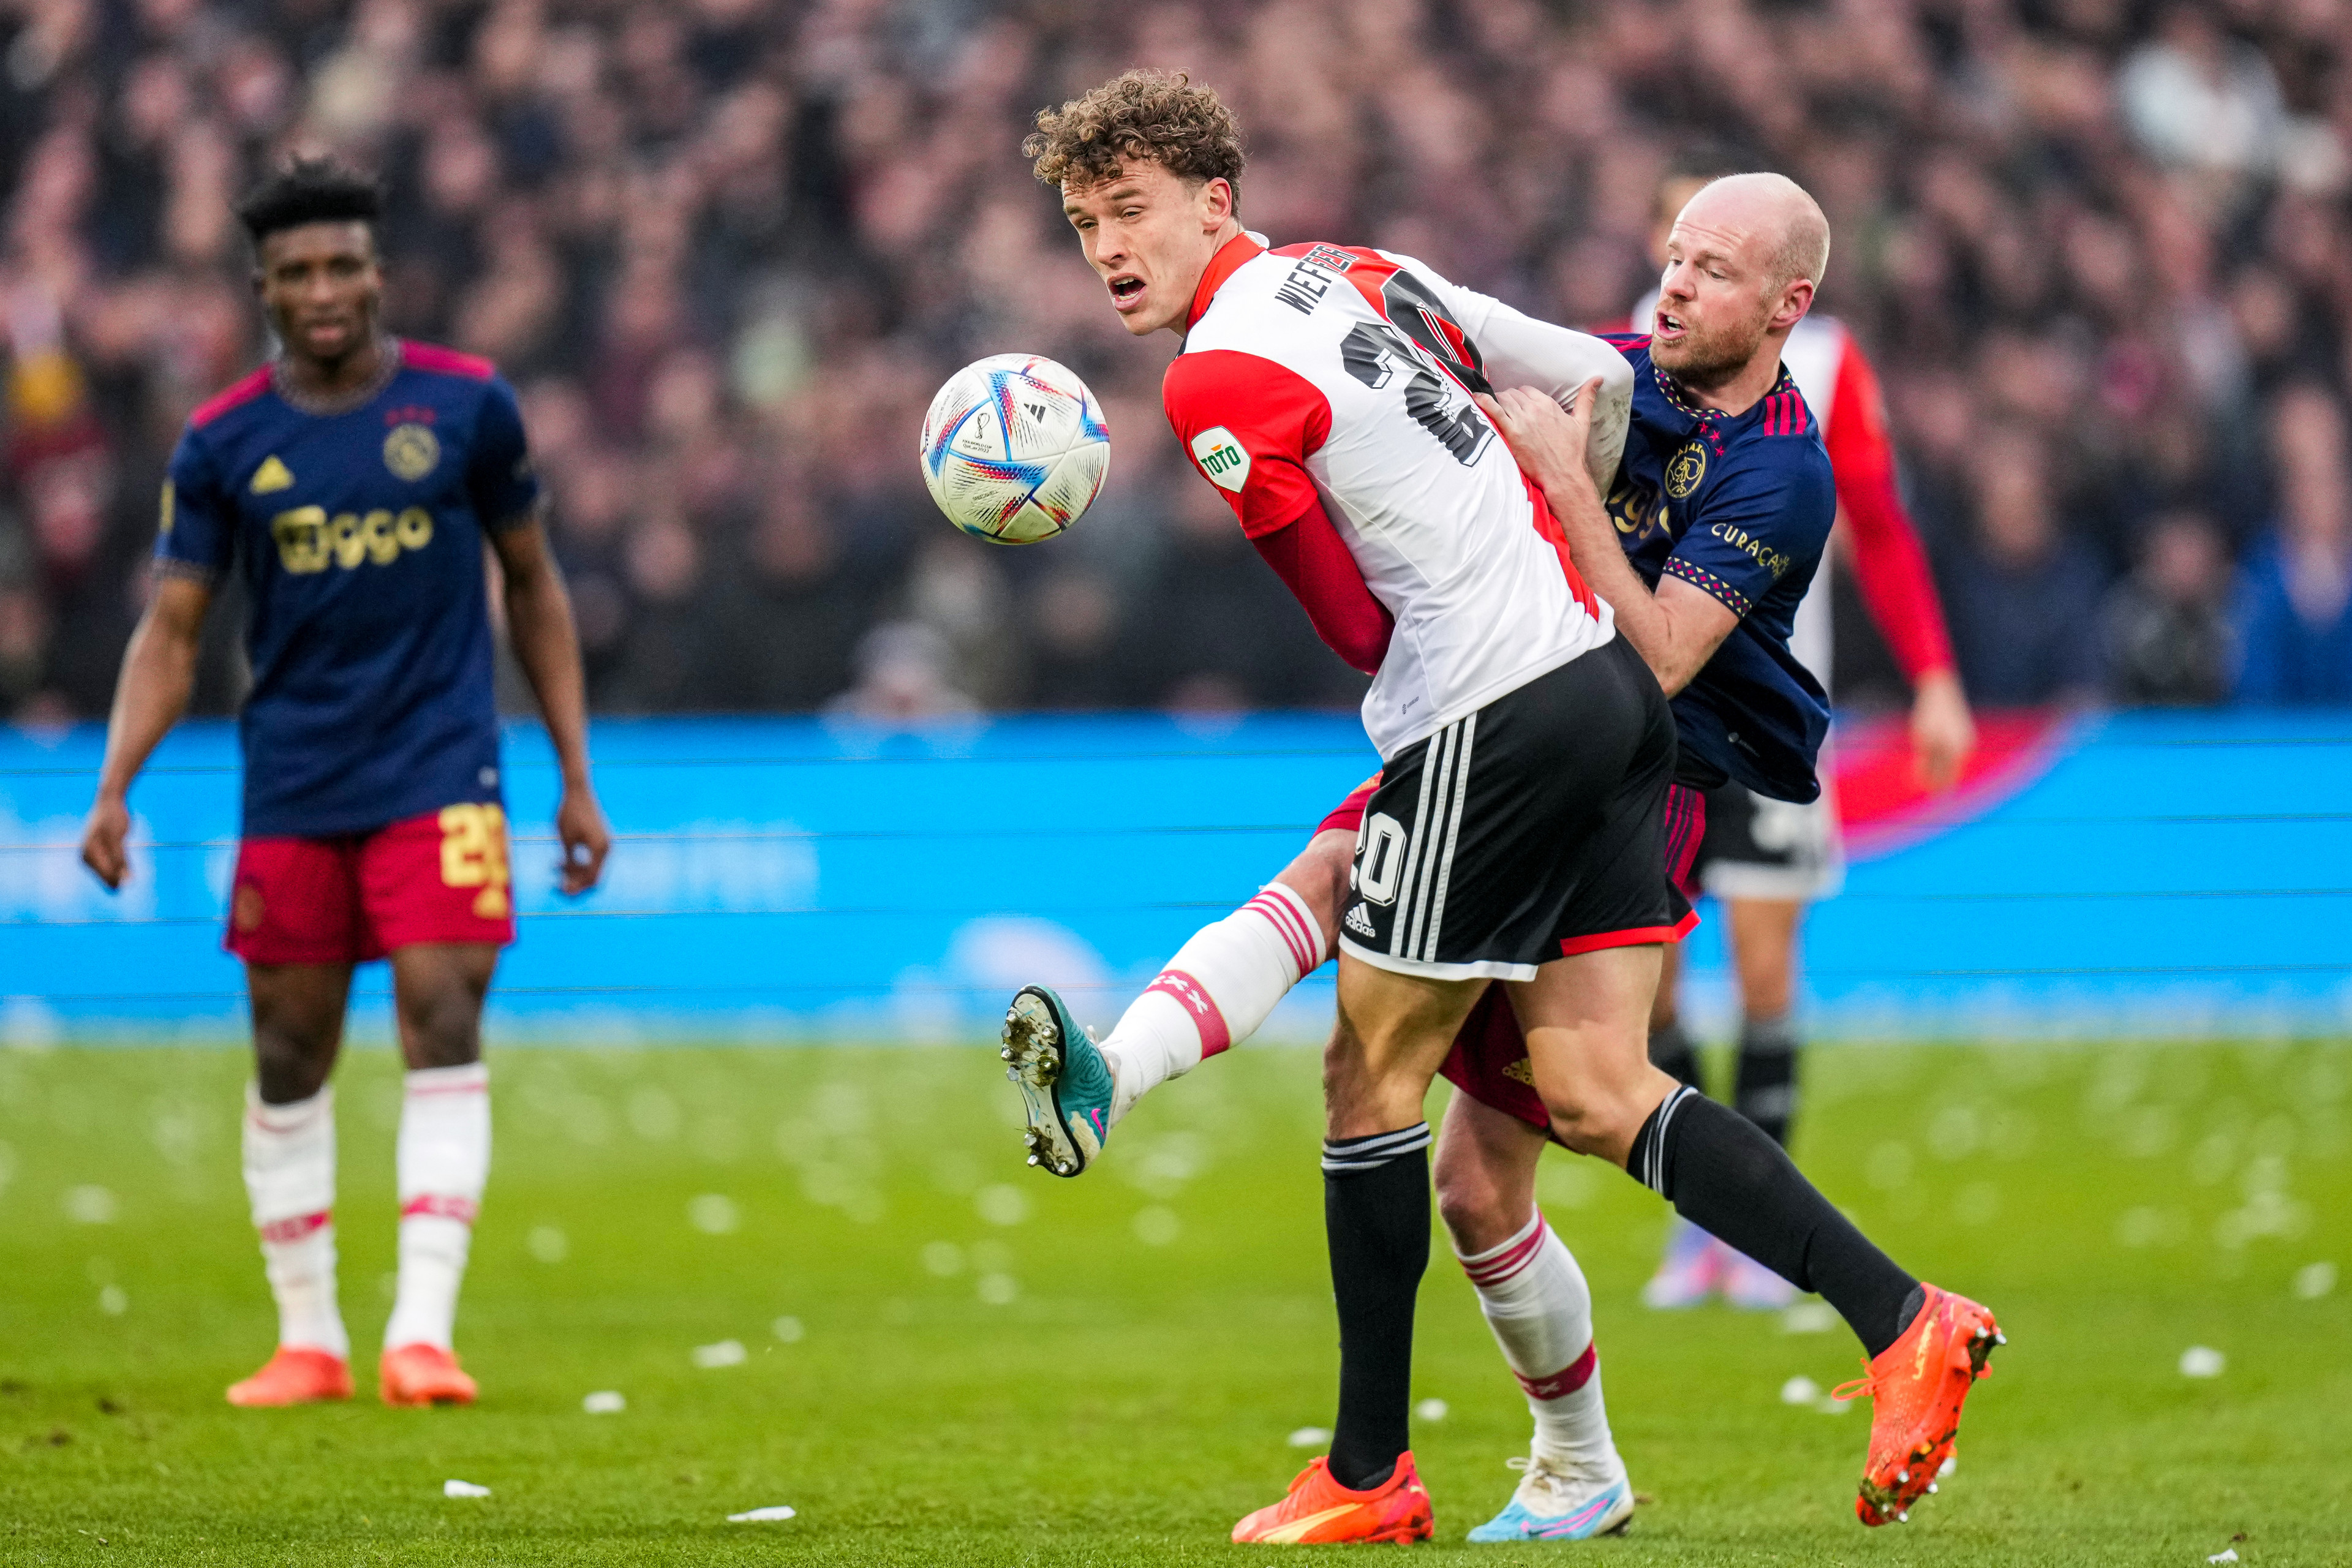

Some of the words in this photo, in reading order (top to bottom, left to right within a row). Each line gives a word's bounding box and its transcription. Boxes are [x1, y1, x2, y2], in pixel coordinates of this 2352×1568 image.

[1275, 245, 1360, 315] WIEFFER
[1340, 268, 1499, 468] 20
[1200, 445, 1241, 476] TOTO
[1678, 442, 1703, 457] AJAX
[1345, 915, 1376, 938] adidas
